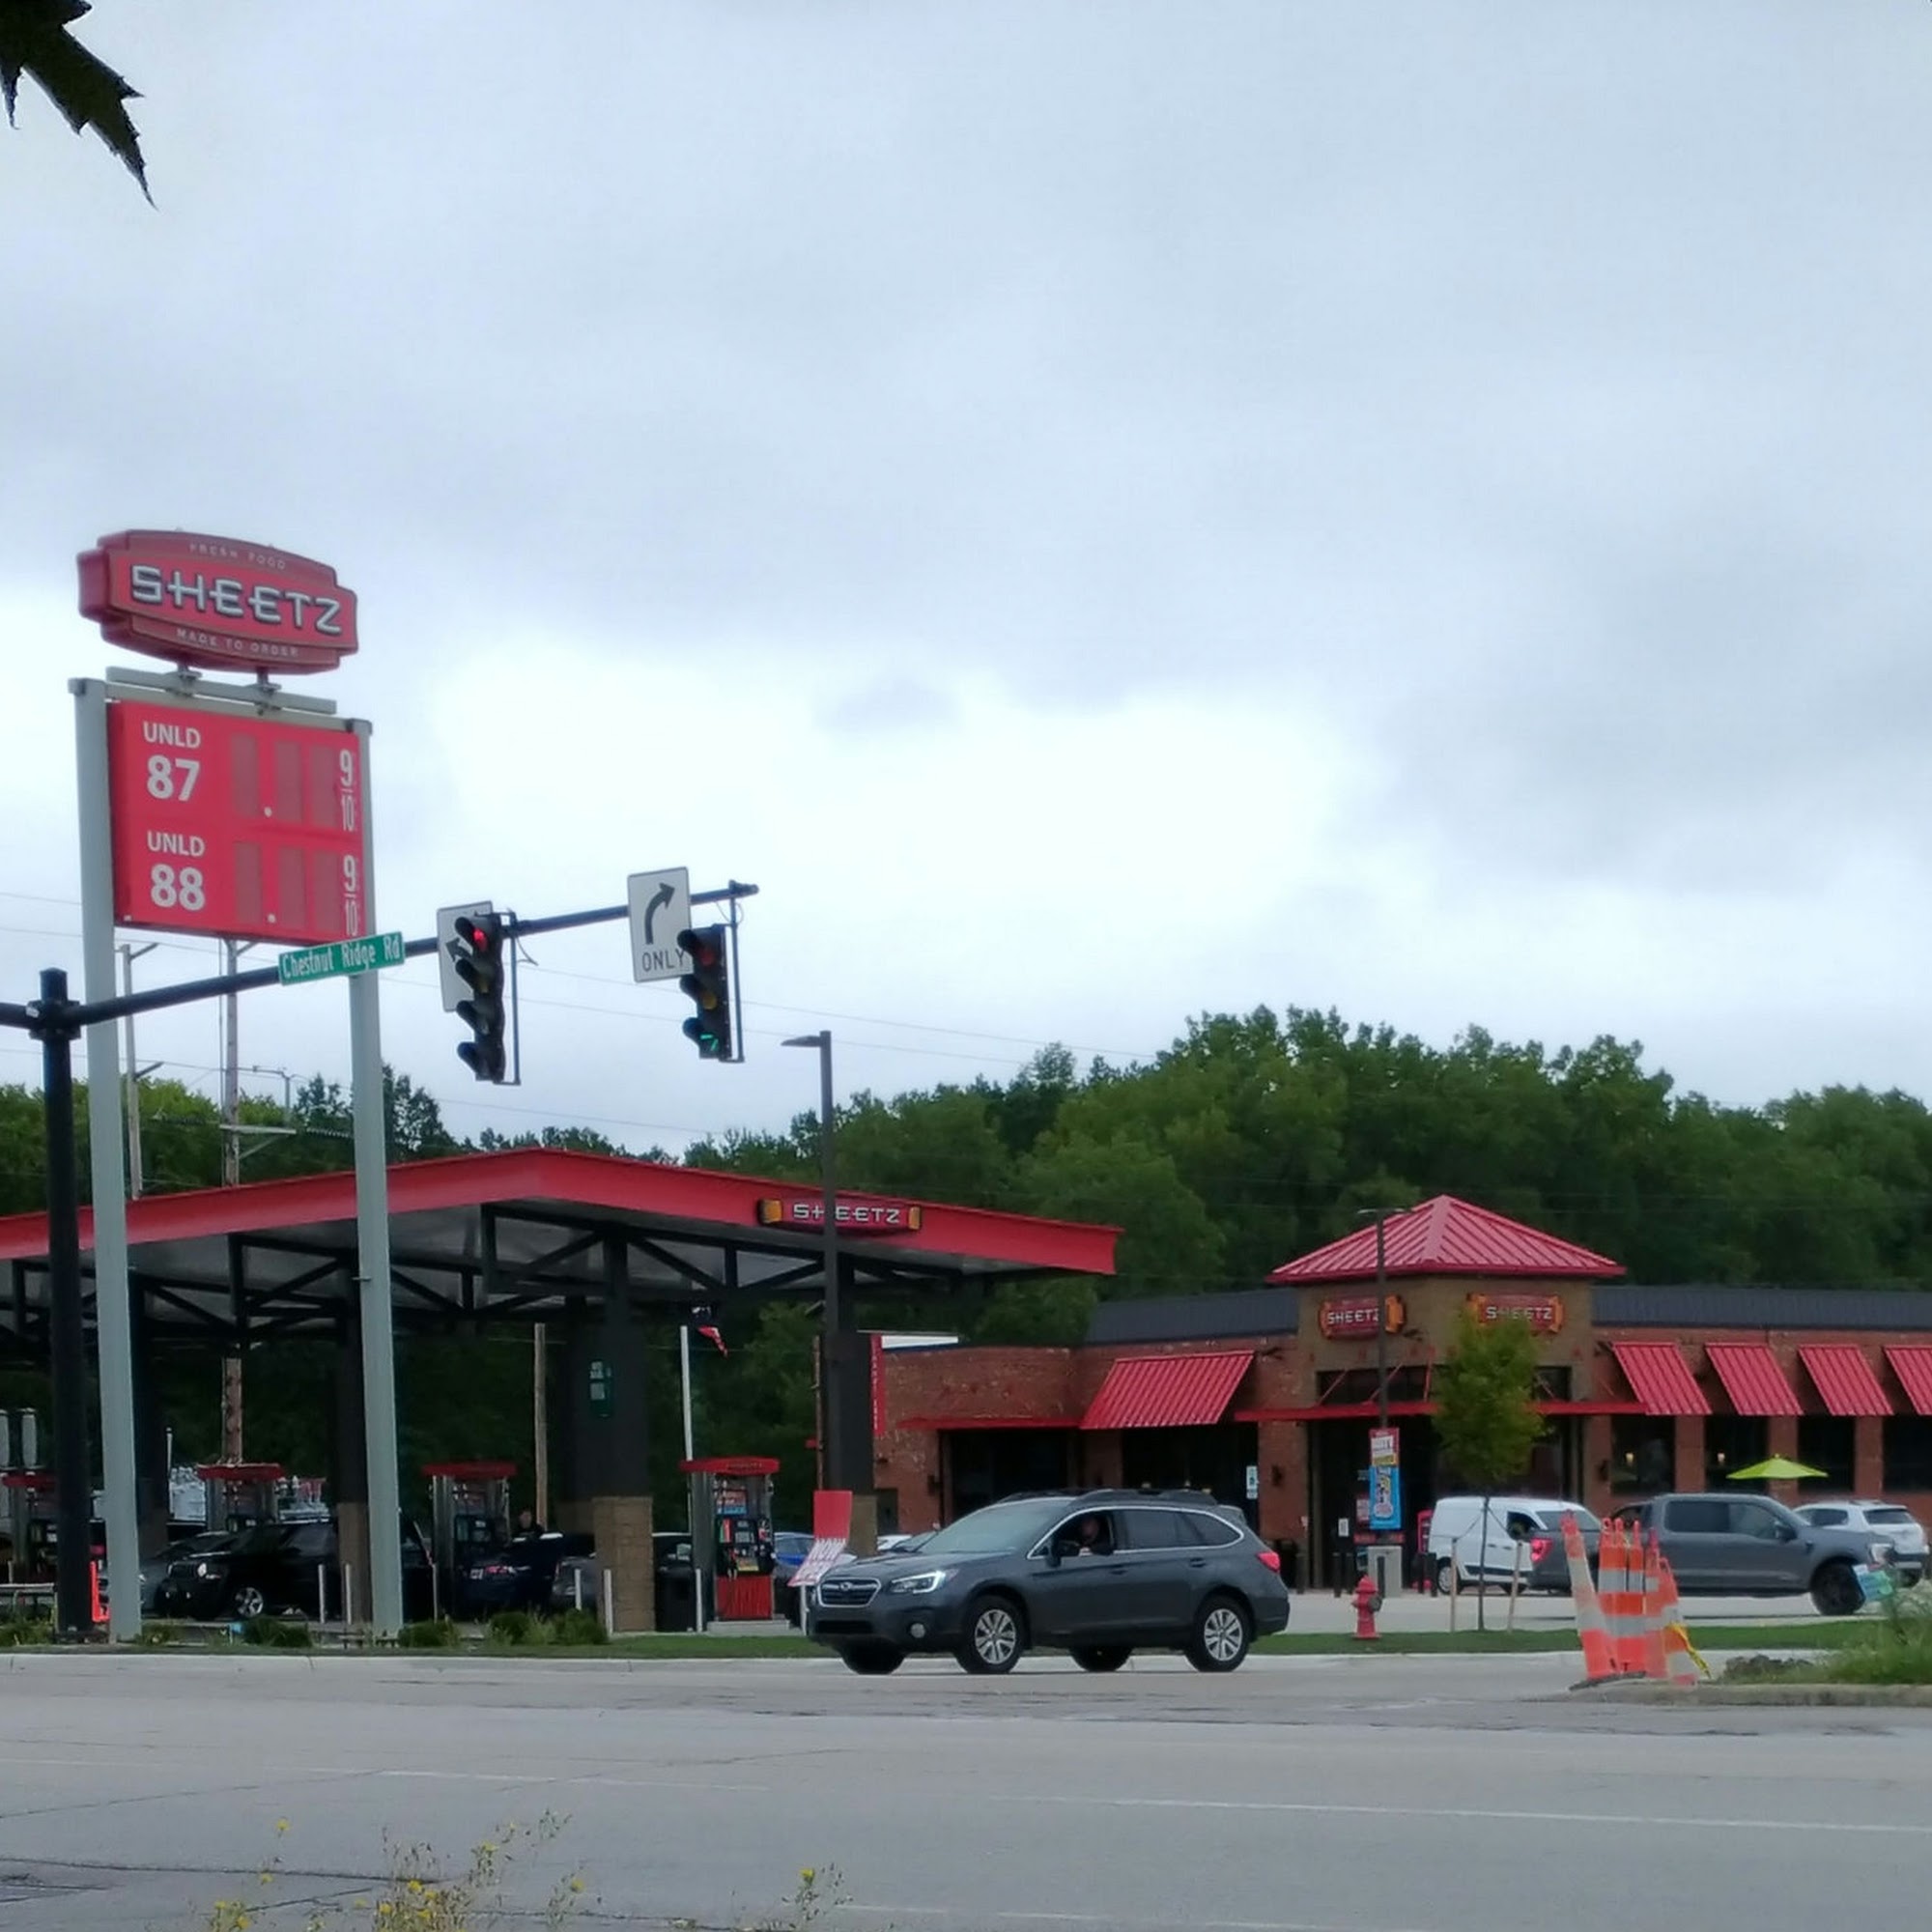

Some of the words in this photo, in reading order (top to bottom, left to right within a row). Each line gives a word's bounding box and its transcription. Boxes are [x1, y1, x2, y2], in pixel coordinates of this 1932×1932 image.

[189, 543, 239, 558] FRESH
[248, 553, 287, 570] FOOD
[130, 563, 343, 636] SHEETZ
[176, 628, 218, 647] MADE
[225, 638, 242, 651] TO
[249, 642, 299, 658] ORDER
[142, 721, 201, 749] UNLD
[147, 754, 201, 802] 87
[147, 830, 205, 857] UNLD
[150, 864, 206, 911] 88
[282, 948, 334, 979] Chestnut
[341, 942, 376, 971] Ridge
[383, 934, 400, 961] Rd
[641, 948, 686, 972] ONLY
